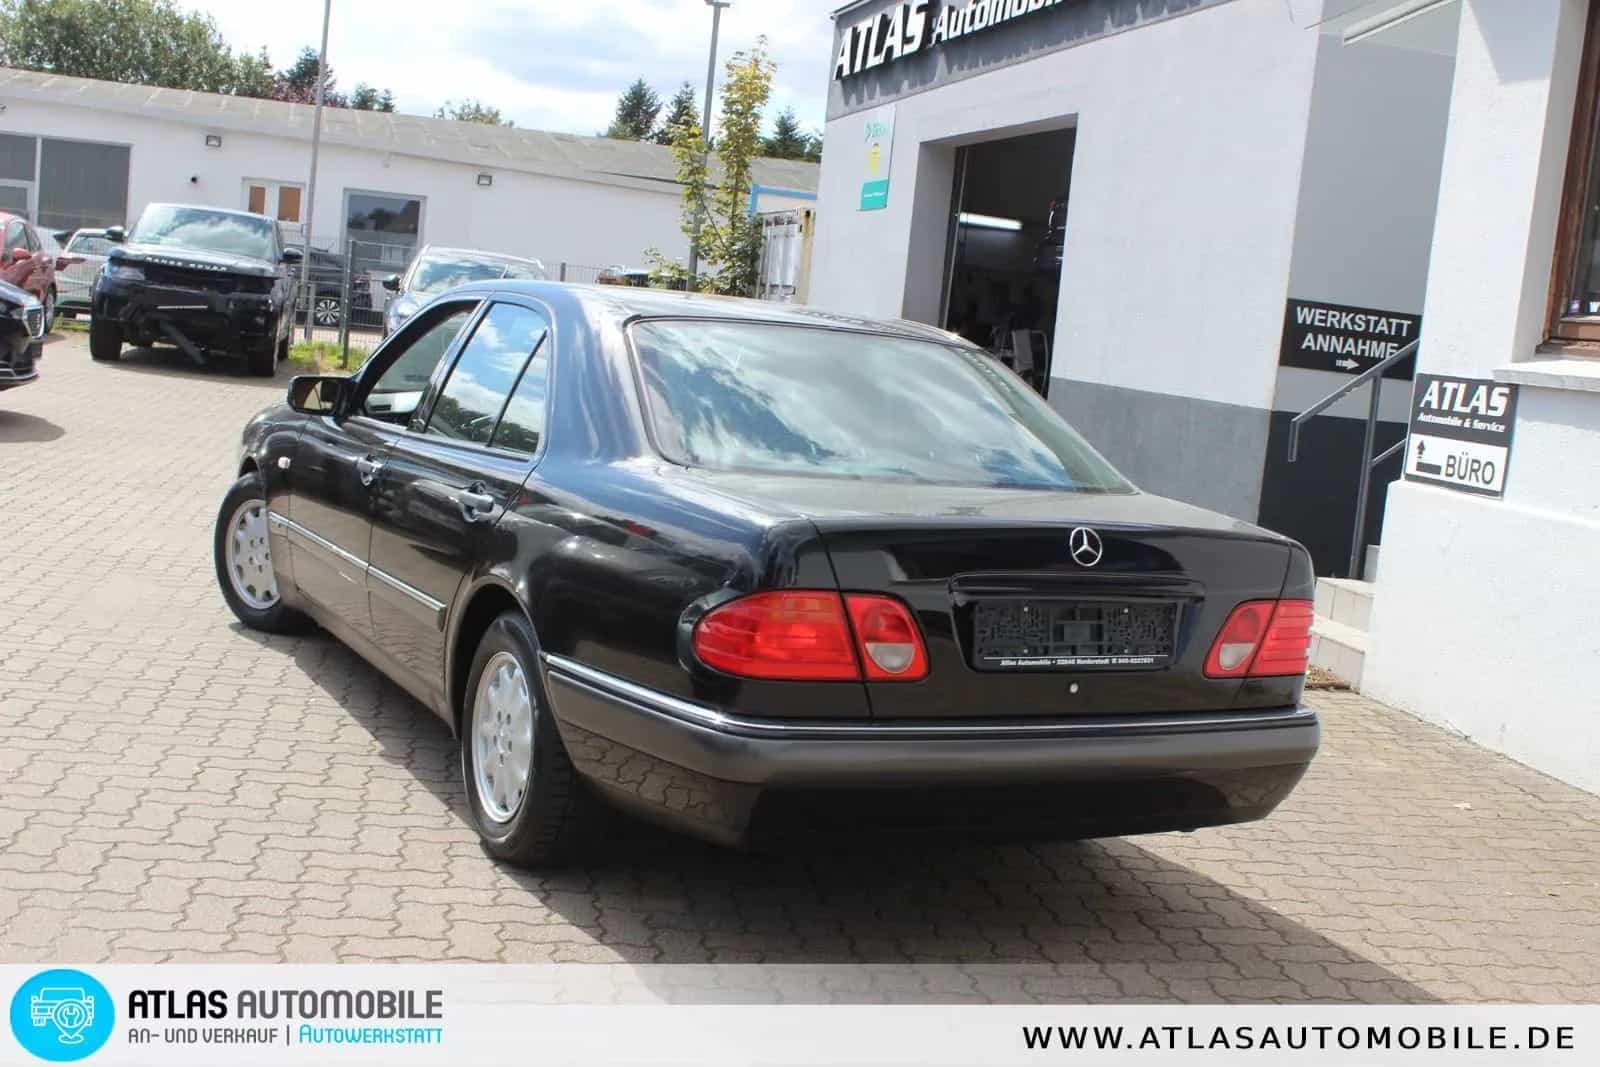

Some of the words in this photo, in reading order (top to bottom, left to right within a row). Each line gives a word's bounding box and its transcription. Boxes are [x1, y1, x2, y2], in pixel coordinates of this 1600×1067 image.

[833, 1, 929, 81] ATLAS
[931, 0, 1066, 45] Automo
[1296, 306, 1413, 337] WERKSTATT
[1301, 332, 1400, 359] ANNAHME
[1419, 380, 1511, 417] ATLAS
[1417, 411, 1462, 428] Automobile
[1463, 418, 1472, 429] &
[1472, 420, 1505, 433] Service
[1444, 451, 1496, 485] BÜRO
